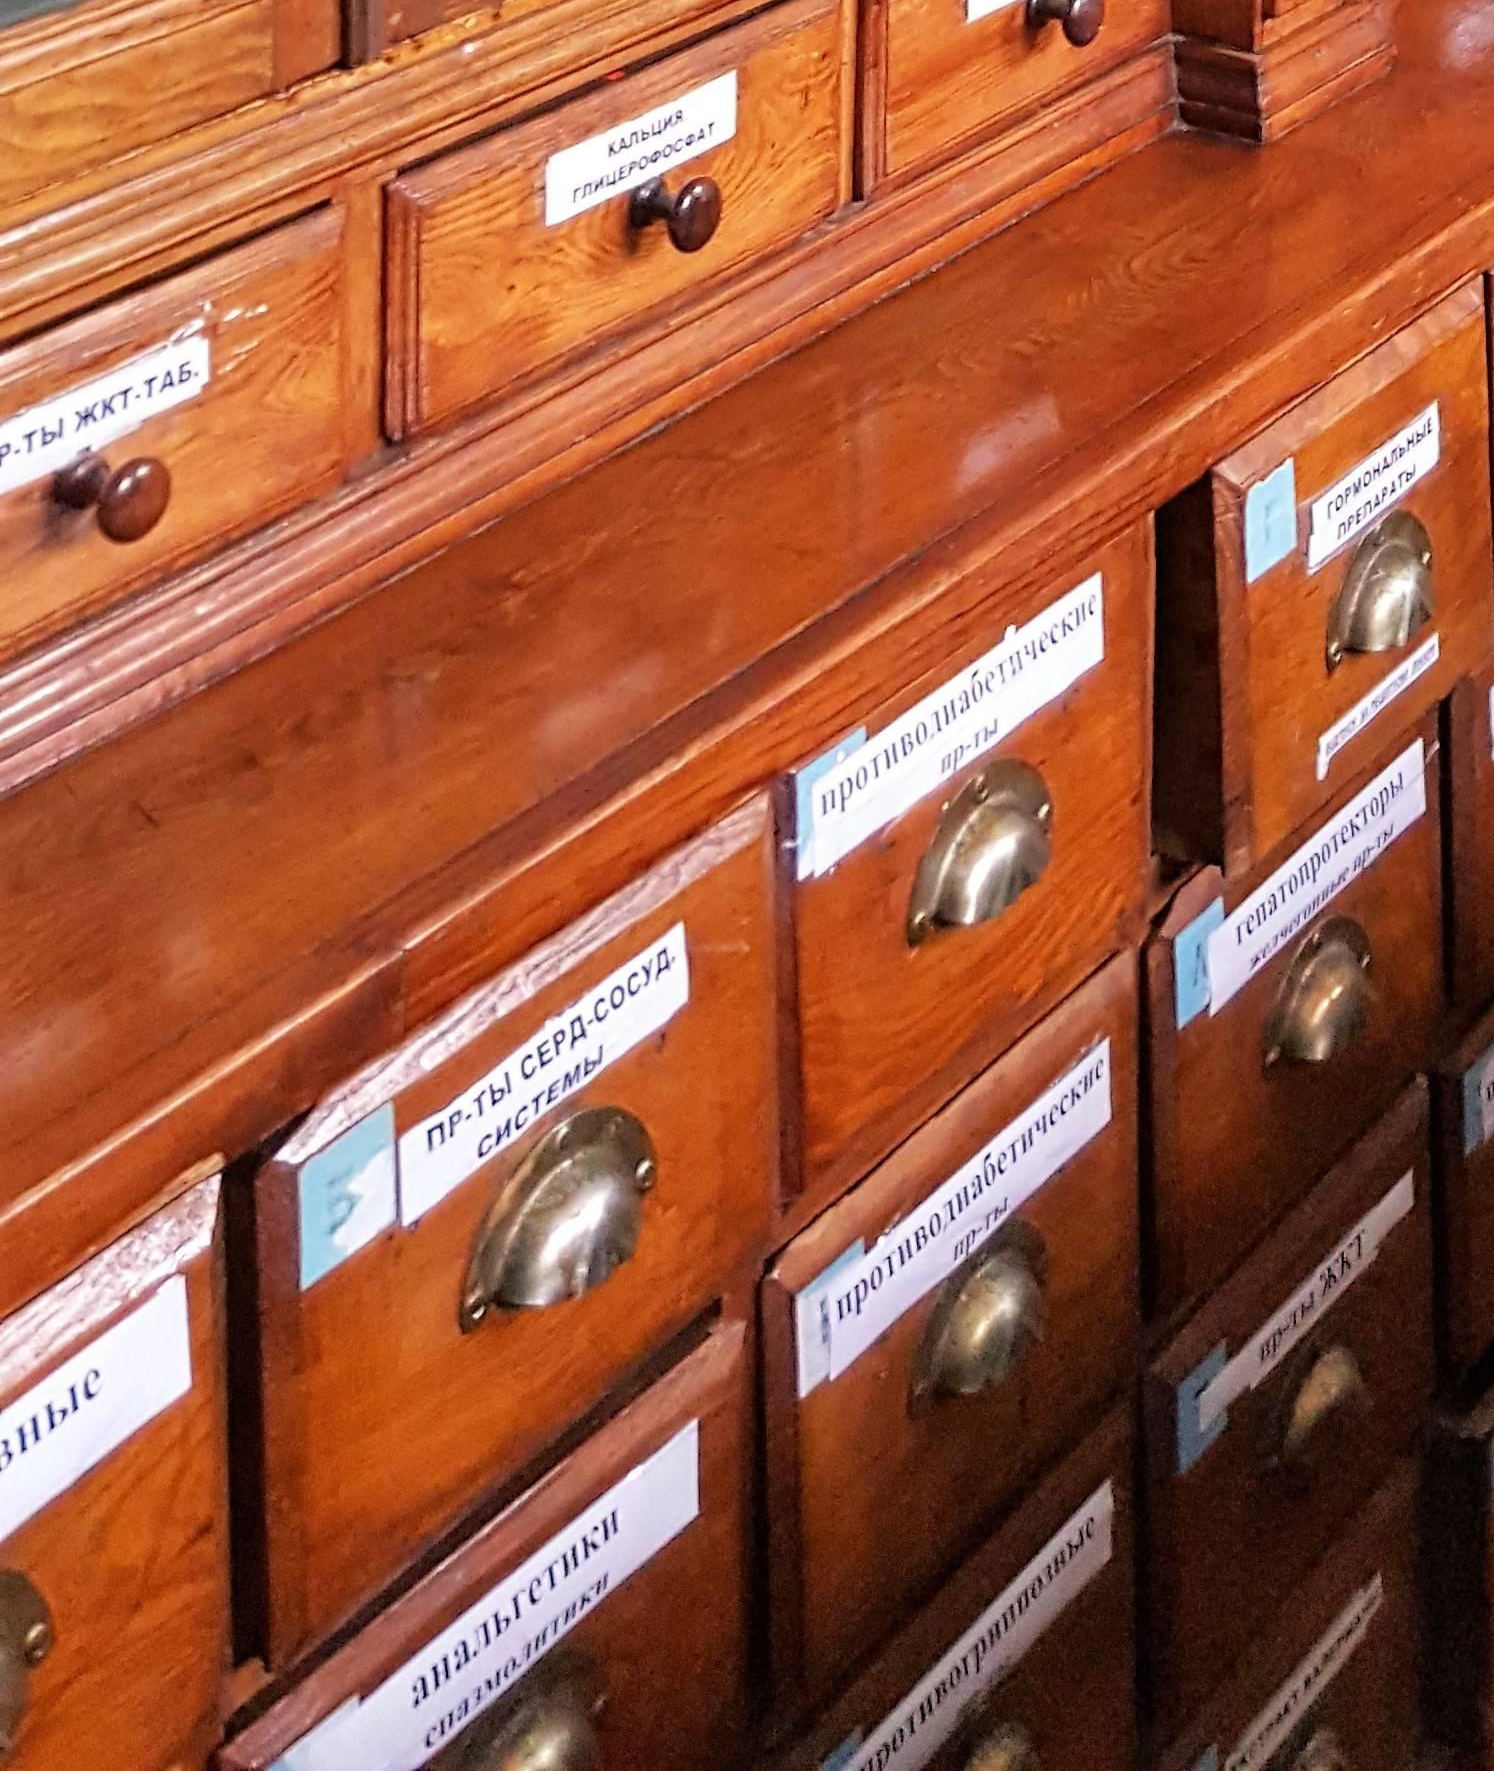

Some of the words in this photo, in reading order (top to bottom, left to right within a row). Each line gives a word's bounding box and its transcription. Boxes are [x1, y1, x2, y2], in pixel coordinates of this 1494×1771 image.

[571, 121, 716, 205] ГЛИЦЕРОФОСФАТ
[607, 109, 684, 158] КАЛЬЦИЯ
[74, 361, 200, 433] ЖКТ-ТАБ.
[1327, 416, 1434, 521] ГОРМОНАЛЬНЫЕ
[1337, 463, 1417, 541] ПРЕПАРАТЫ
[820, 592, 1097, 817] противодиабетические
[940, 718, 1000, 775] пр-ты
[1234, 771, 1405, 947] гепатопротекторы
[1249, 865, 1350, 972] желчегонные
[1352, 823, 1395, 877] пр-ты
[426, 1070, 513, 1154] ПР-ТЫ
[519, 946, 677, 1083] СЕРД-СОСУД.
[477, 1044, 604, 1161] СИСТЕМЫ
[835, 1057, 1105, 1323] противодиабетические
[952, 1196, 1010, 1263] пр-ты
[411, 1506, 622, 1709] анальгетики
[422, 1571, 610, 1751] спазмолитики
